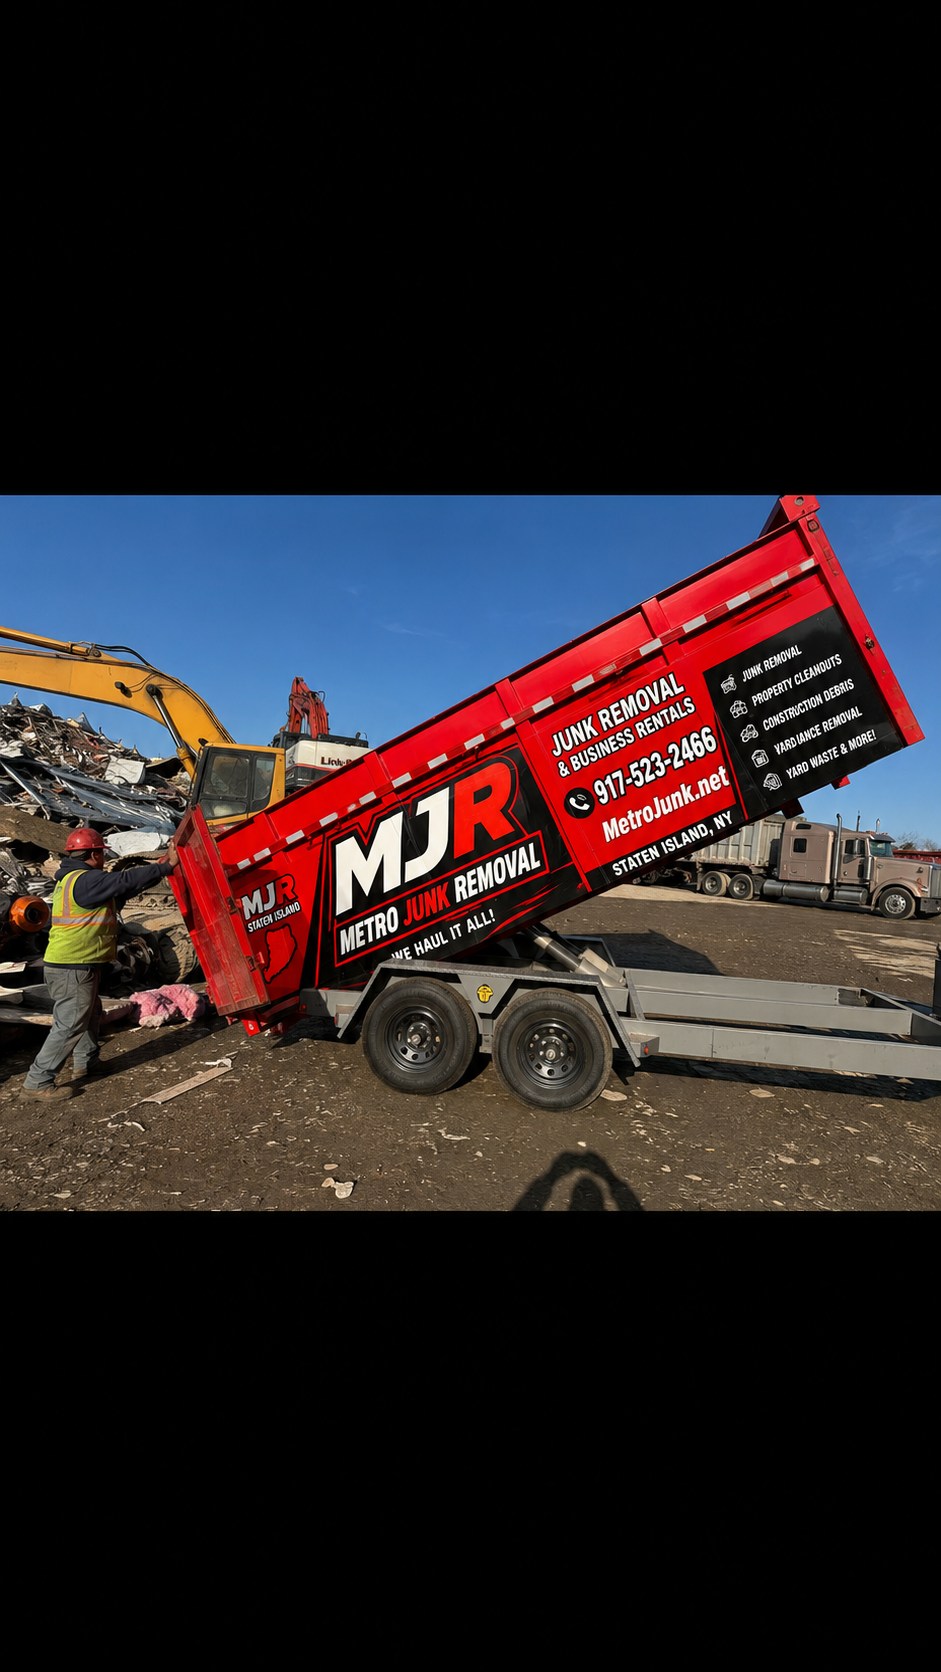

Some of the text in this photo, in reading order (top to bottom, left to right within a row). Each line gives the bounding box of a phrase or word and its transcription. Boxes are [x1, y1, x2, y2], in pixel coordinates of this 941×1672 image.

[742, 645, 802, 682] JUNK REMOVAL
[751, 654, 842, 706] PROPERTY CLEANOUTS
[552, 672, 684, 757] JUNK REMOVAL
[763, 679, 854, 731] CONSTRUCTION DEBRIS
[822, 706, 862, 732] REMOVAL
[558, 697, 695, 777] & BUSINESS RENTALS
[593, 727, 717, 804] 917-523-2466
[786, 729, 876, 779] YARD WASTE & MORE!
[602, 766, 730, 842] MetroJunk.net
[335, 762, 515, 916] MJR
[612, 811, 732, 875] STATEN ISLAND, NY
[241, 874, 298, 920] MJR
[340, 842, 540, 955] METRO JUNK REMOVAL
[414, 931, 448, 956] HAUL
[449, 923, 462, 940] IT
[466, 908, 496, 933] ALL!
